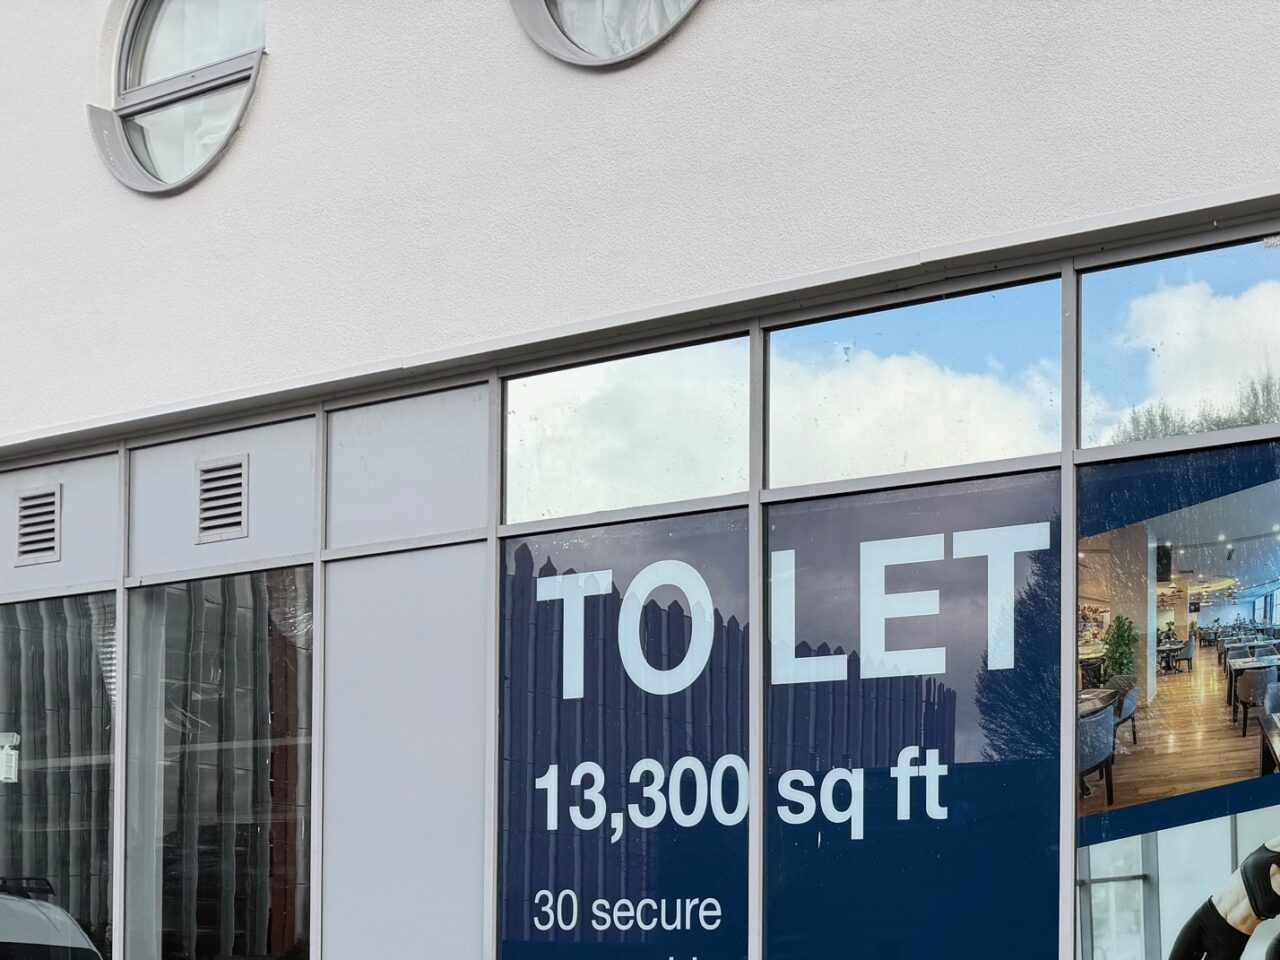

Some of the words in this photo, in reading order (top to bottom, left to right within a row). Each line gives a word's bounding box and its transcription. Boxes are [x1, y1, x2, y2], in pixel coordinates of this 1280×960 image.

[536, 559, 715, 700] TO
[770, 521, 1051, 685] LET
[535, 753, 750, 844] 13,300
[776, 767, 864, 840] sq
[890, 745, 948, 821] ft
[533, 889, 579, 931] 30
[591, 897, 723, 931] secure
